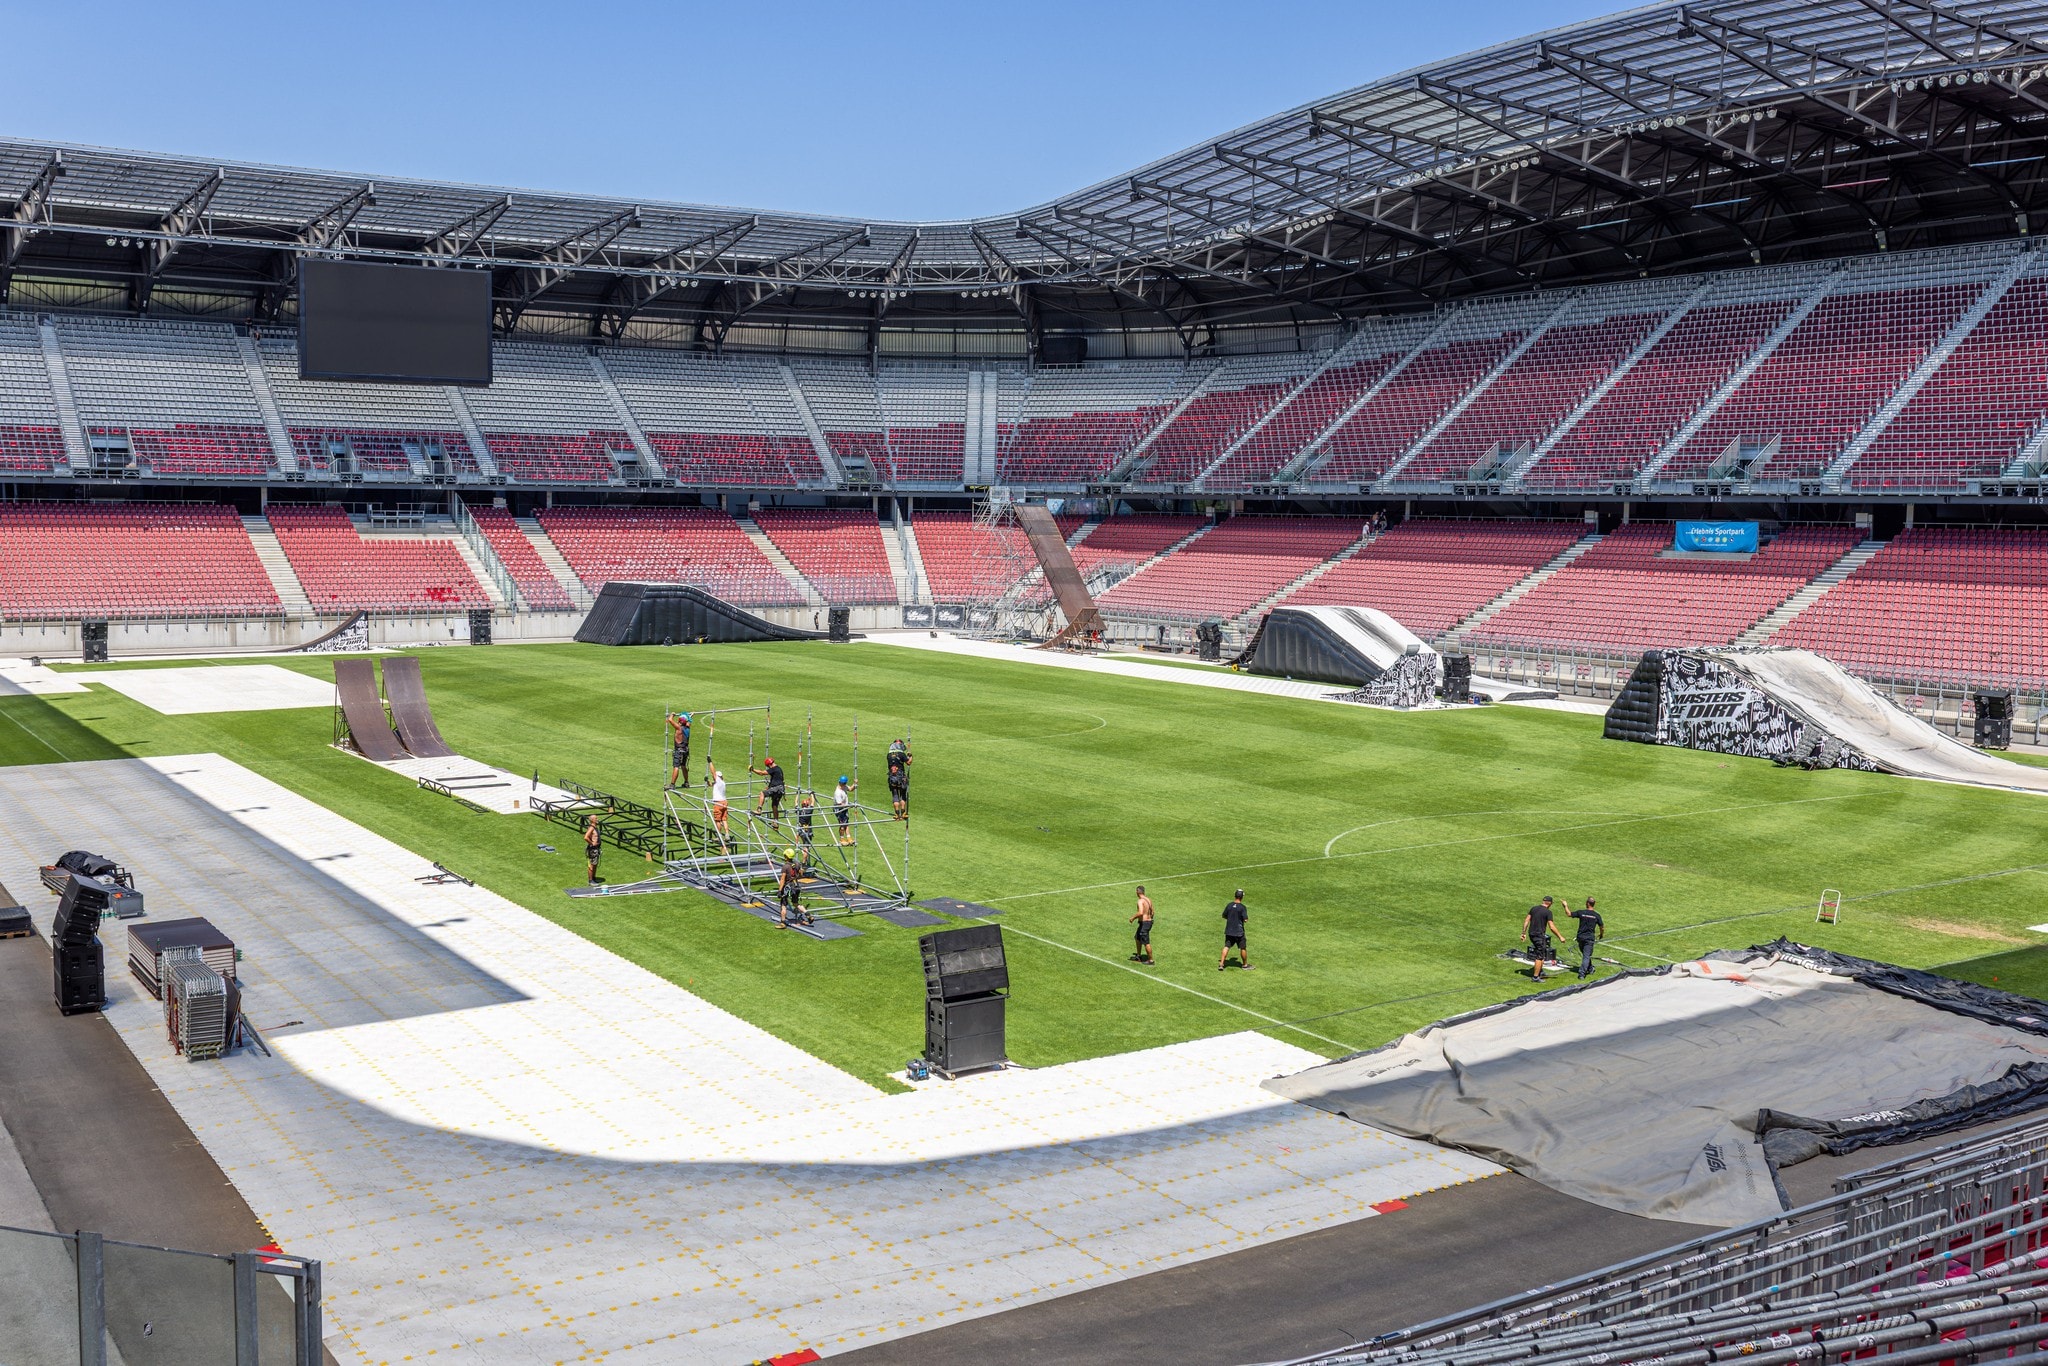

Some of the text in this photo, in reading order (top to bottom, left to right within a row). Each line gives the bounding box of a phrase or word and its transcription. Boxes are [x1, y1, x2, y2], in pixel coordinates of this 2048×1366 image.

[1715, 527, 1745, 536] Sportpark
[1671, 691, 1746, 704] MASTERS
[1670, 705, 1687, 715] OF
[1686, 703, 1743, 718] DIRT
